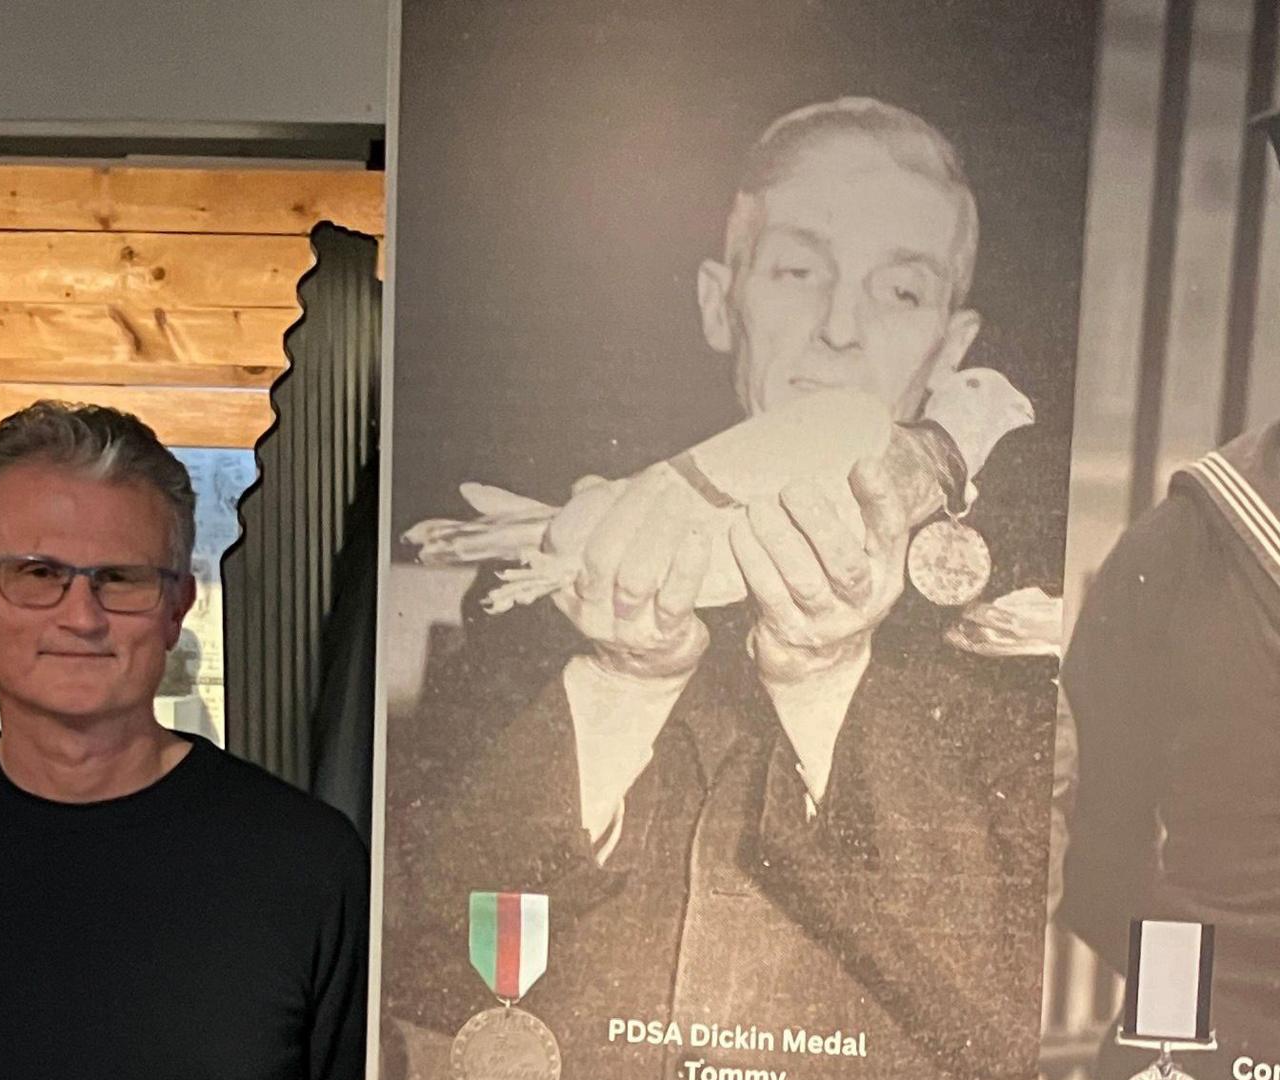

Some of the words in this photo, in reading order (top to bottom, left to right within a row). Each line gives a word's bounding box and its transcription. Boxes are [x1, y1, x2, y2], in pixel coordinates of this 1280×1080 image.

[608, 1018, 684, 1047] PDSA
[690, 1022, 775, 1053] Dickin
[782, 1028, 868, 1058] Medal
